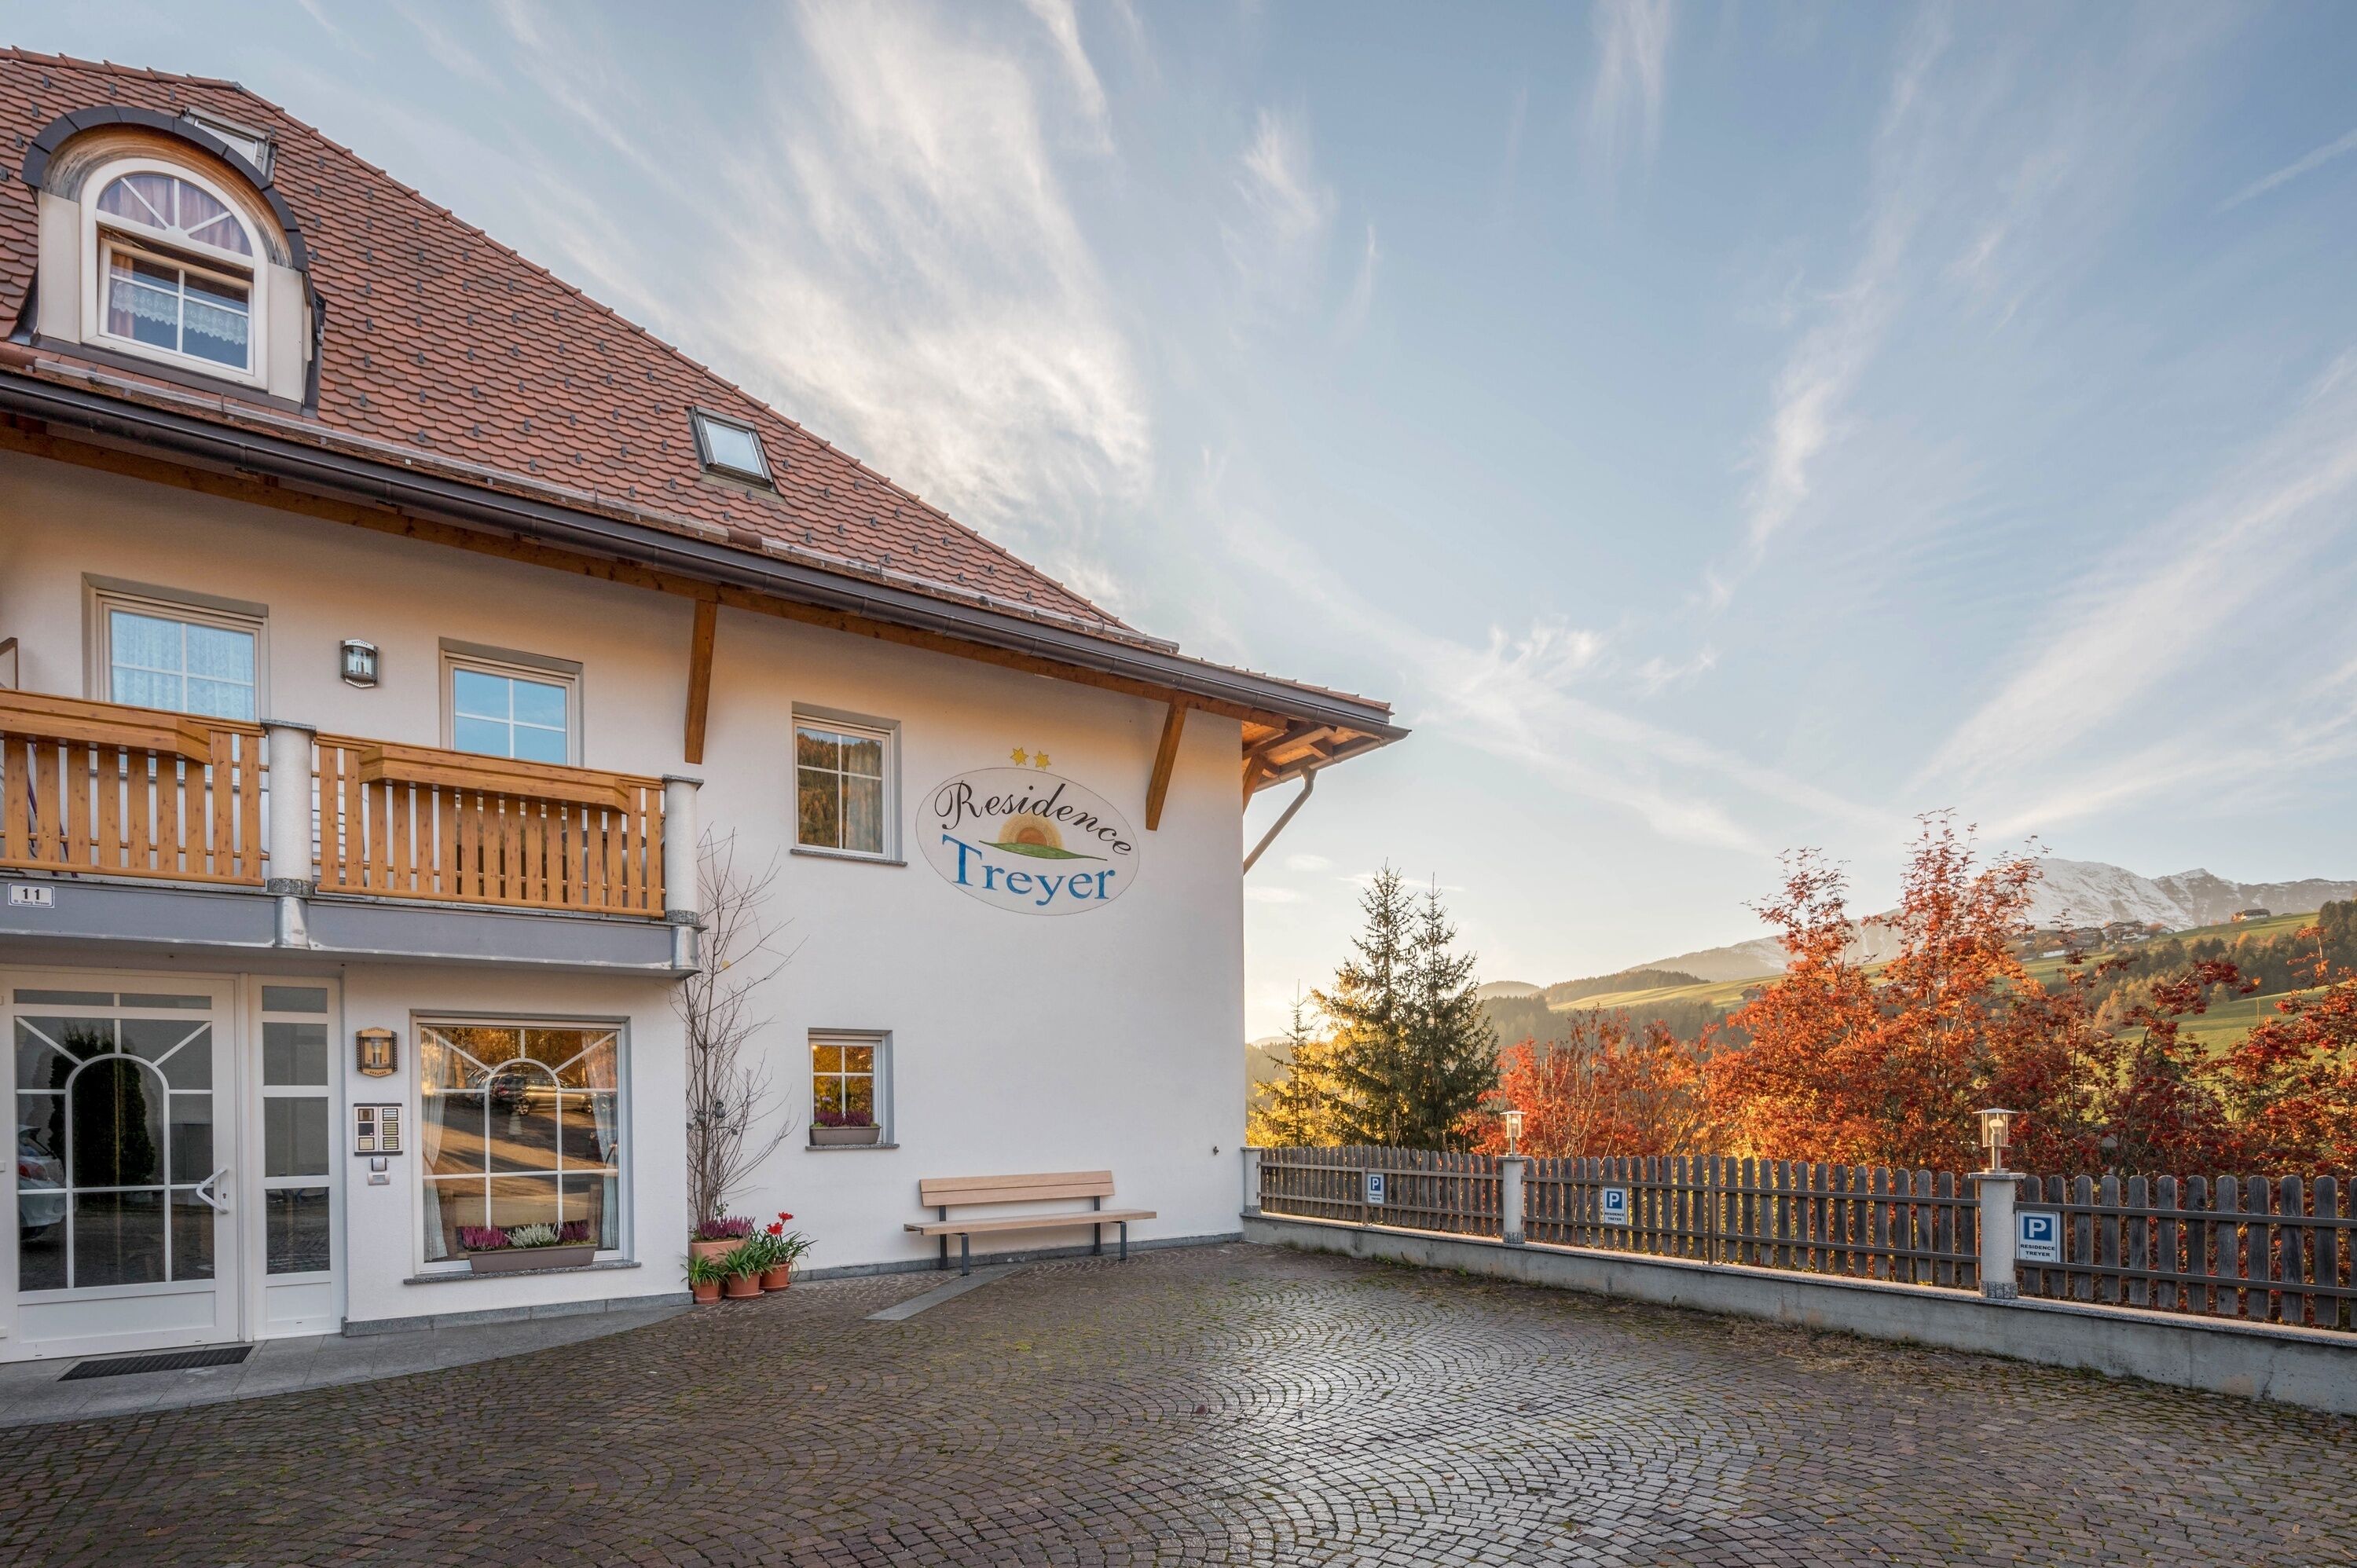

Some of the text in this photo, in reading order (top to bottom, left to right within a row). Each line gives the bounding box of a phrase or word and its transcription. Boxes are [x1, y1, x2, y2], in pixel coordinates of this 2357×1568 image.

[934, 780, 1132, 855] Residence
[942, 833, 1116, 906] Treyer
[23, 888, 40, 900] 11
[1372, 1178, 1380, 1190] P
[1609, 1192, 1620, 1207] P
[2029, 1218, 2047, 1238] P
